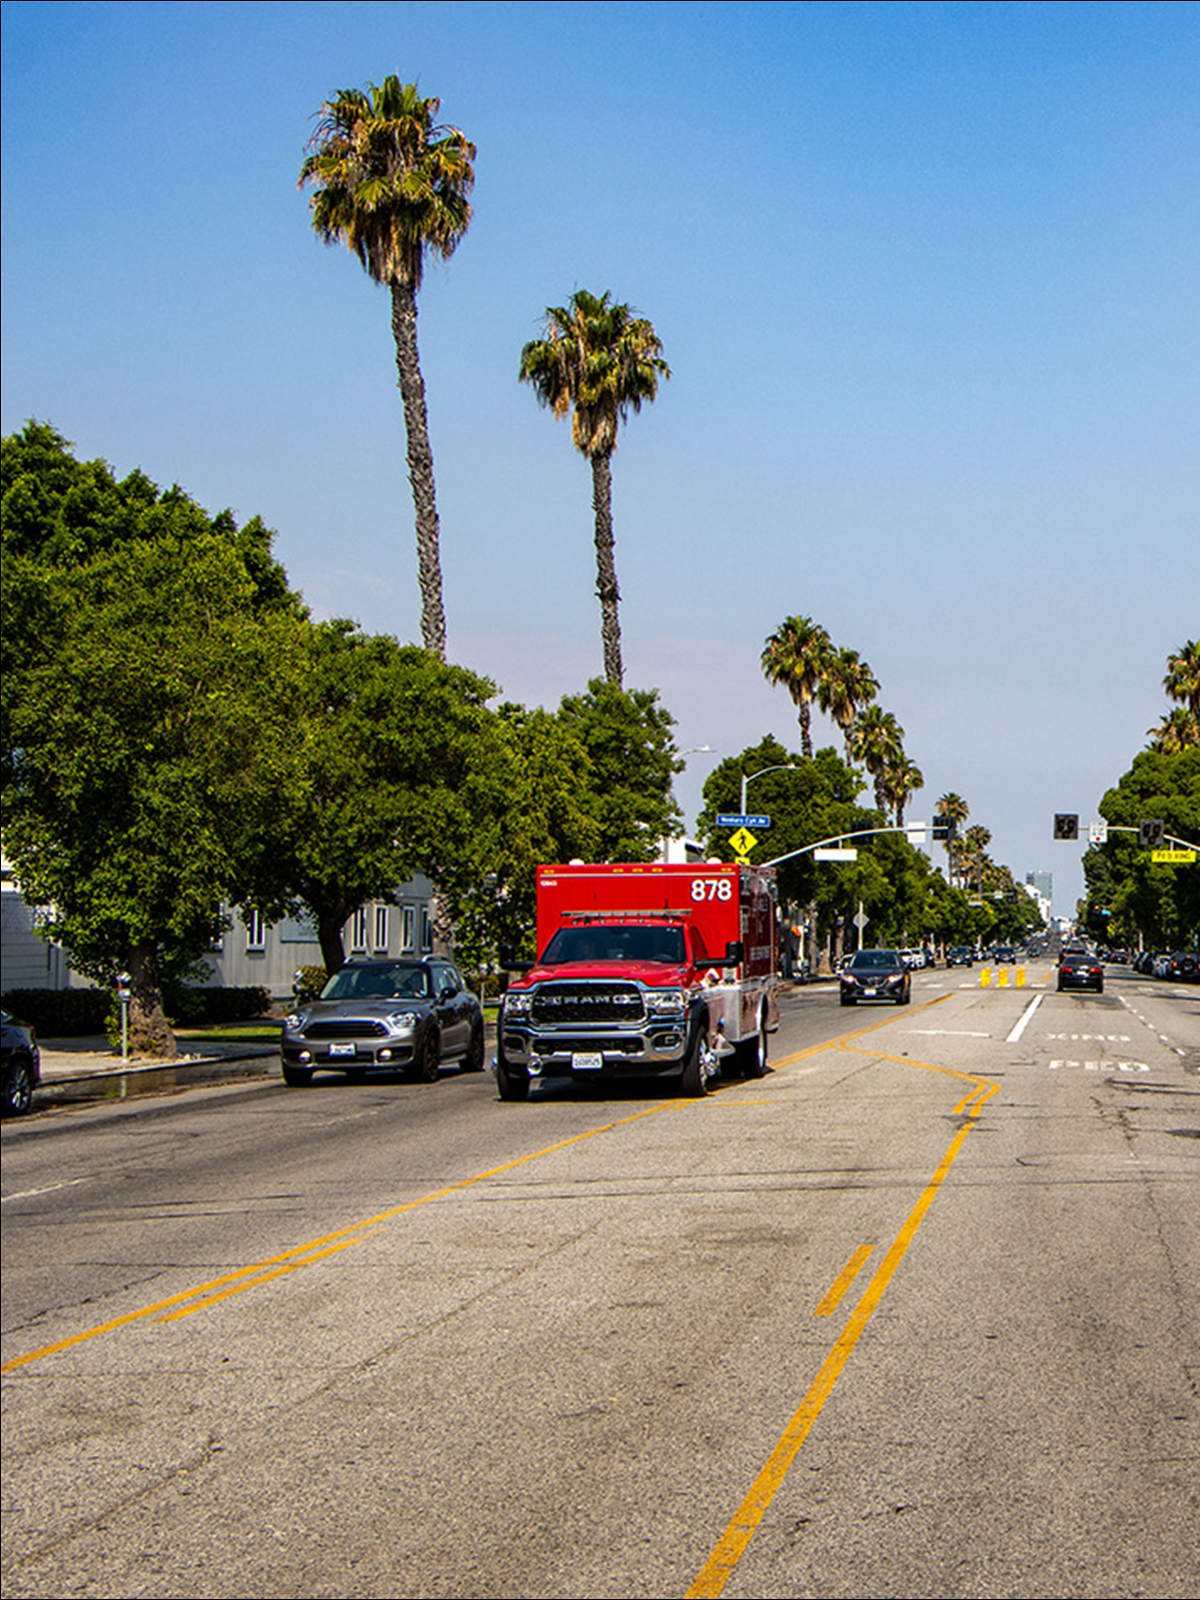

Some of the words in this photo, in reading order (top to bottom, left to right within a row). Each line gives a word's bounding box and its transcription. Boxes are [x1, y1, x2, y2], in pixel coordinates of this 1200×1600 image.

[1156, 852, 1172, 860] PED
[691, 879, 732, 902] 878
[563, 996, 610, 1005] RAM
[1048, 1060, 1151, 1072] PED
